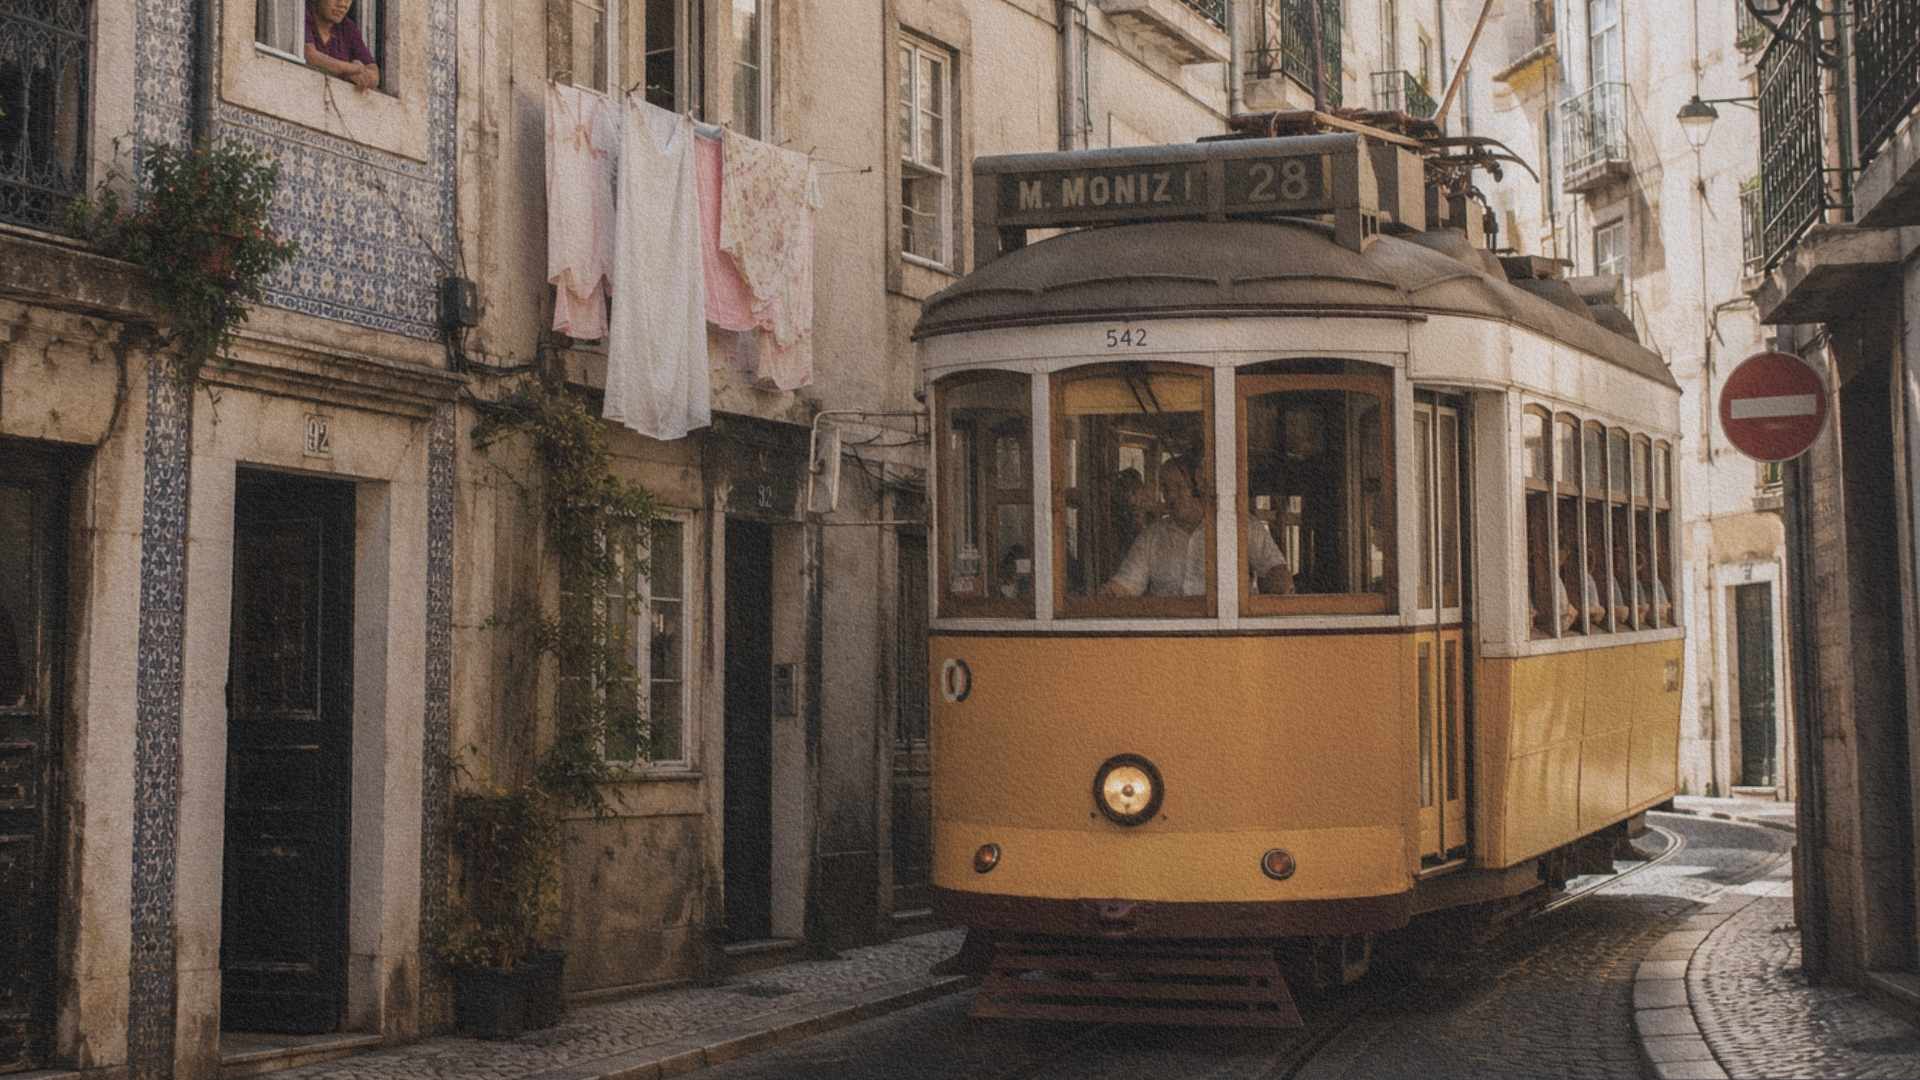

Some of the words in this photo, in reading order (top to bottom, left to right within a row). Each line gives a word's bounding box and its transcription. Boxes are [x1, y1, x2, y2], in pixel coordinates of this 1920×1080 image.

[1018, 180, 1051, 209] M.
[1061, 172, 1172, 207] MONIZ
[1248, 159, 1309, 202] 28
[1106, 328, 1147, 348] 542
[308, 418, 329, 452] 92
